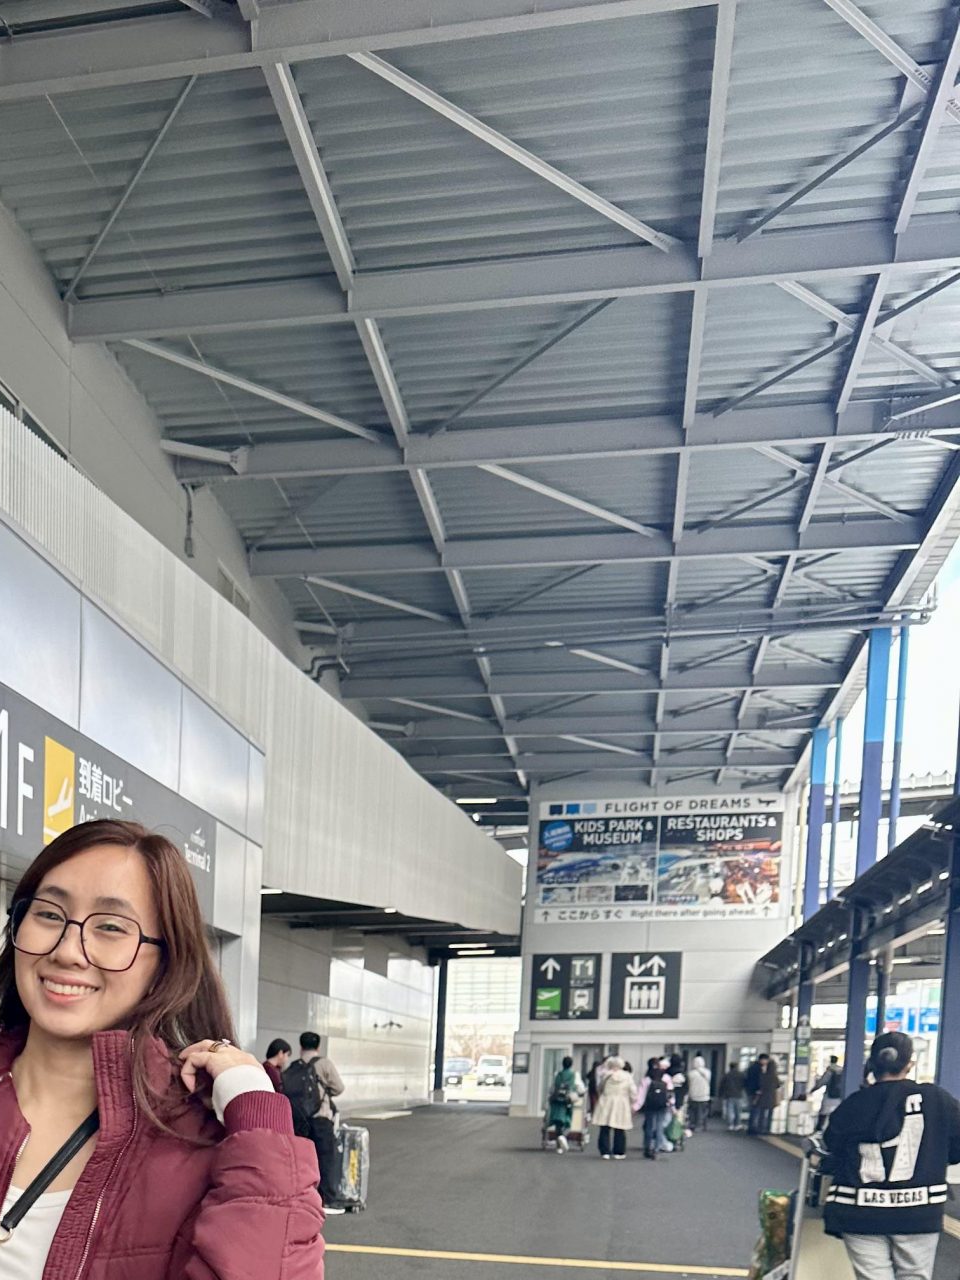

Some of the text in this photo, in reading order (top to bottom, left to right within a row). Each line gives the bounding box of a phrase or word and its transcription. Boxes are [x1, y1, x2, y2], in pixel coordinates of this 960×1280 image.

[78, 757, 133, 812] 到着ロビー
[605, 798, 751, 813] FLIGHT OF DREAMS
[574, 820, 606, 833] KIDS
[608, 818, 644, 832] PARK
[583, 831, 643, 845] MUSEUM
[696, 828, 744, 842] SHOPS
[206, 854, 211, 873] 2
[571, 959, 594, 977] T1
[863, 1191, 924, 1204] LAS VEGAS
